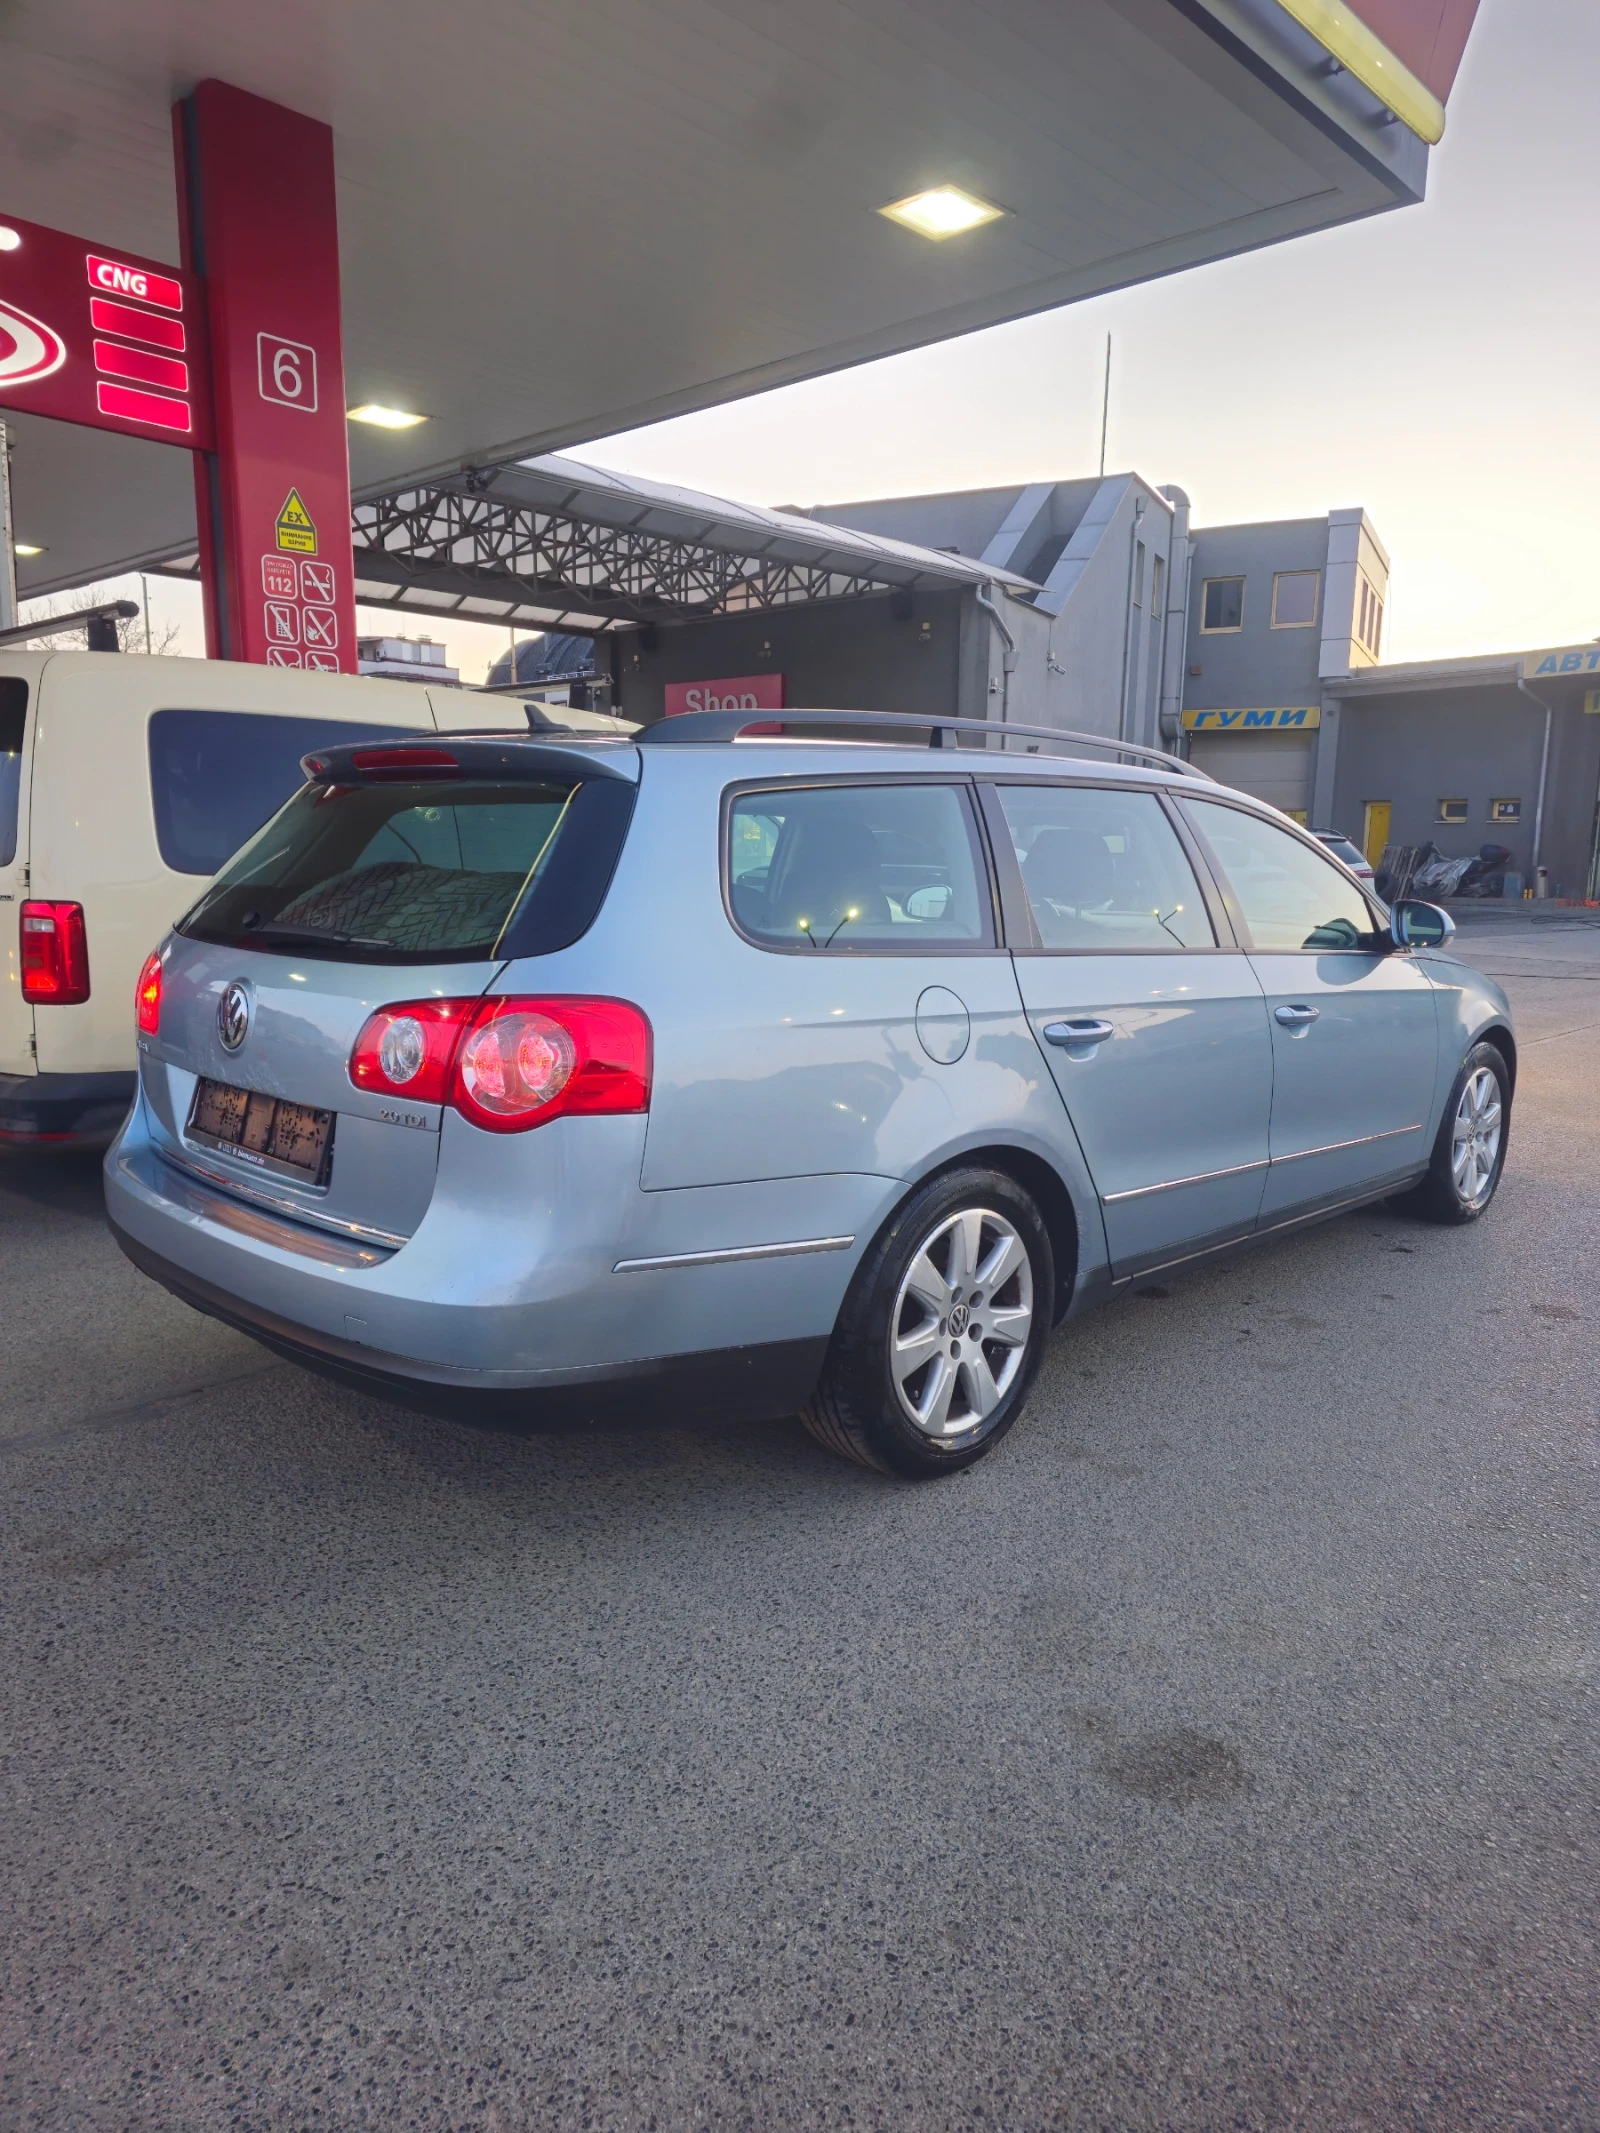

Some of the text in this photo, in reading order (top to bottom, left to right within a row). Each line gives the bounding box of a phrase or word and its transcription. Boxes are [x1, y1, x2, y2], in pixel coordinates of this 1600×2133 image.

[97, 264, 147, 296] CNG
[273, 348, 302, 398] 6
[287, 511, 304, 525] EX
[268, 575, 292, 593] 112
[1193, 709, 1308, 727] ГУМИ
[400, 1112, 426, 1128] TDI
